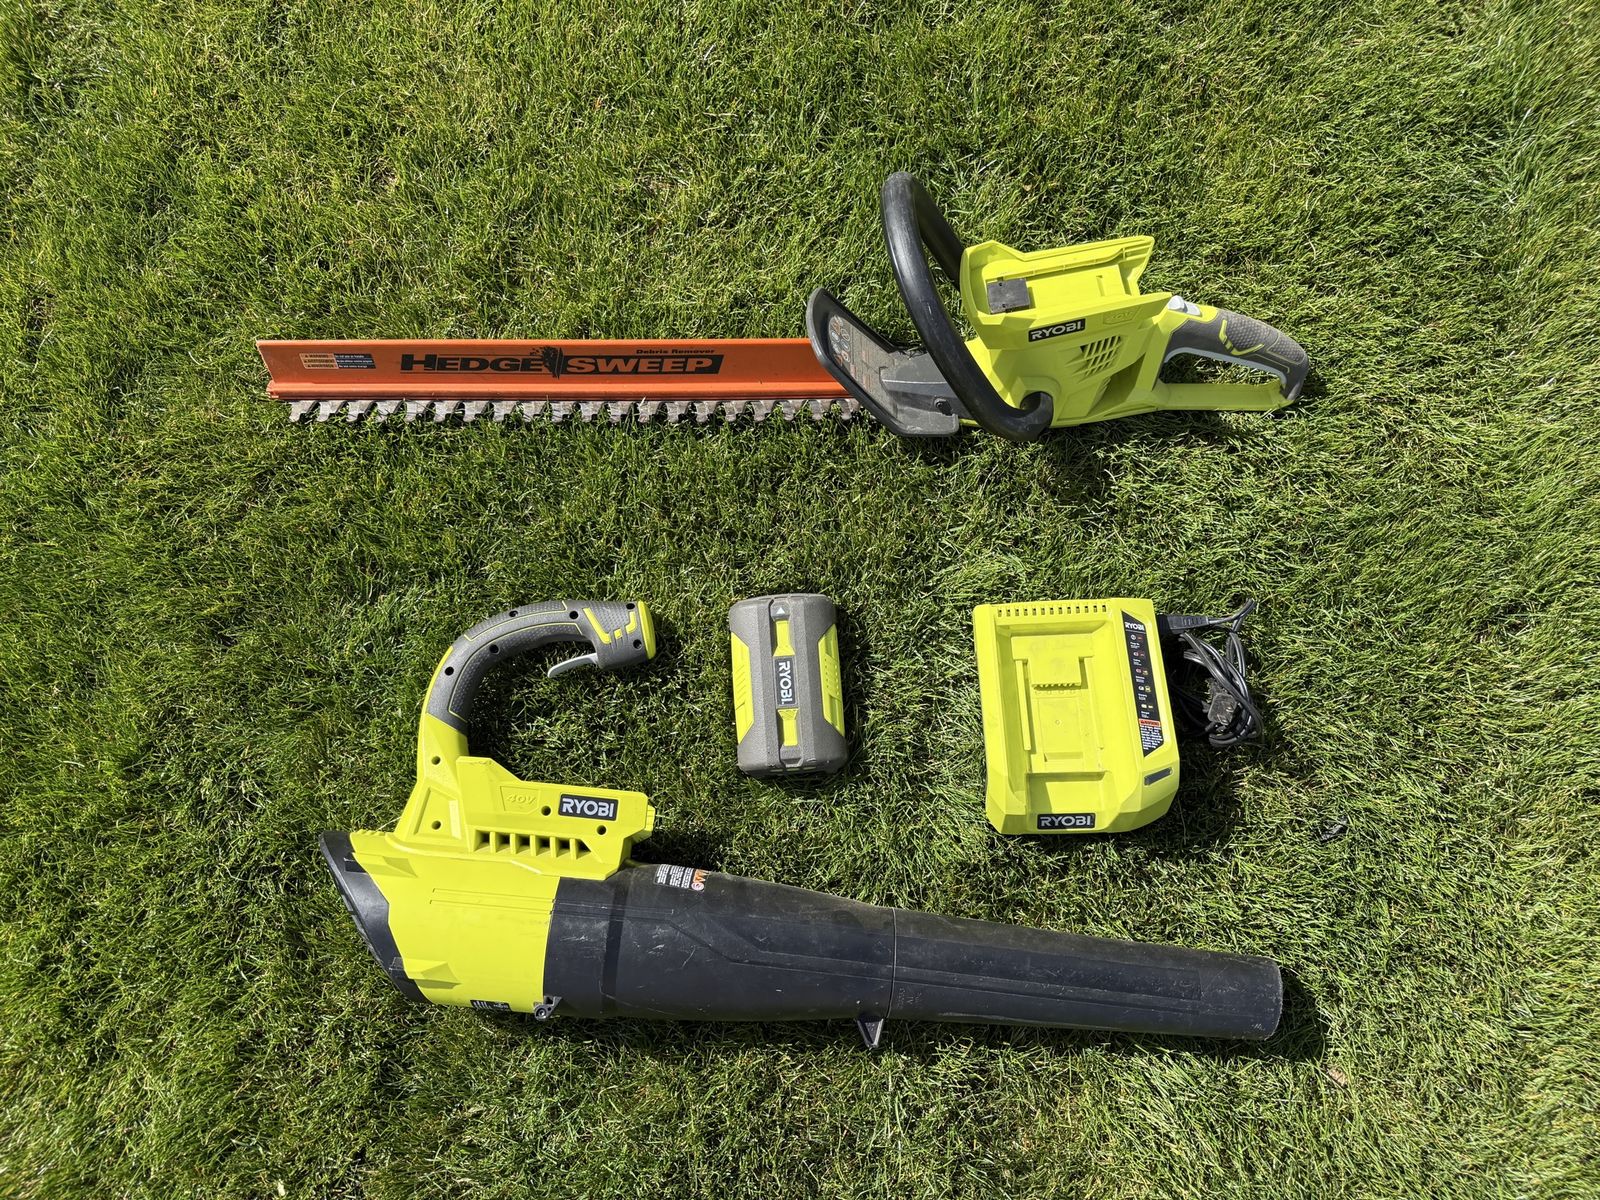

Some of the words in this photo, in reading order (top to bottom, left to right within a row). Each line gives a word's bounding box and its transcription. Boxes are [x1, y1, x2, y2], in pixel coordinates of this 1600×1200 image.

[1030, 321, 1084, 340] RYOBI
[400, 354, 543, 372] HEDGE
[566, 357, 713, 373] SWEEP
[1124, 621, 1145, 631] RYOBI
[778, 661, 793, 705] RYOBI
[506, 794, 536, 805] 40V
[562, 798, 615, 818] RYOBI
[1040, 815, 1094, 827] RYOBI
